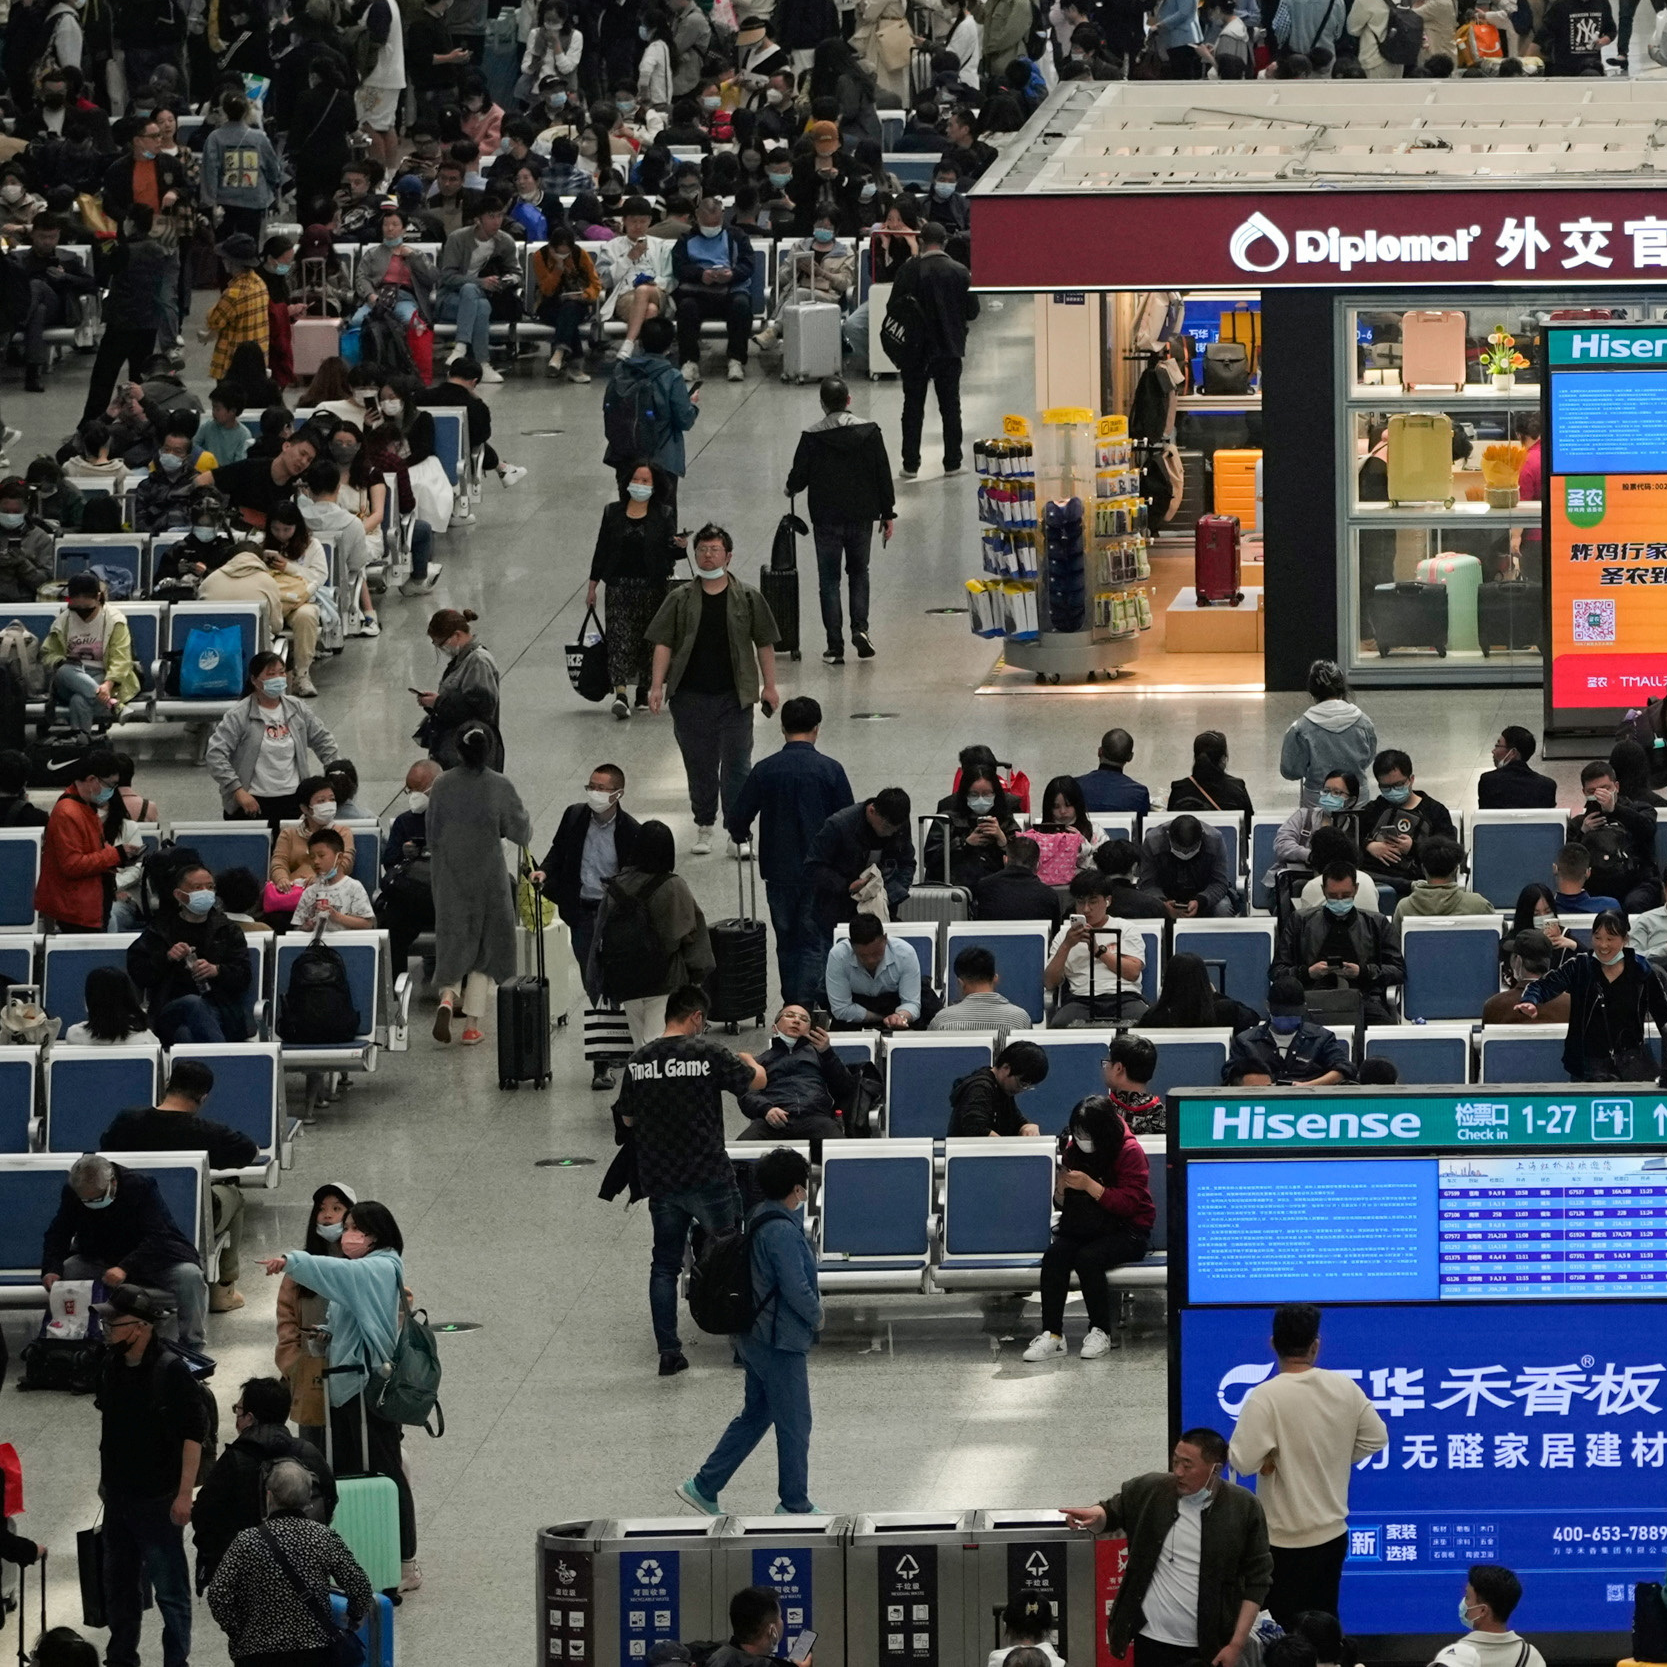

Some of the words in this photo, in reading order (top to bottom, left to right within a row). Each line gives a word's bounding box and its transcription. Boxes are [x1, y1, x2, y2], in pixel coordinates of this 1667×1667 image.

[1296, 223, 1481, 271] Diplomat
[1567, 488, 1604, 507] 圣农
[1587, 676, 1608, 688] 圣农
[664, 1057, 711, 1078] Game
[1211, 1105, 1422, 1141] Hisense
[1455, 1103, 1509, 1126] 检票口
[1520, 1104, 1577, 1134] 1-27
[1456, 1127, 1491, 1141] Check
[1494, 1127, 1509, 1141] in
[1515, 1160, 1613, 1172] 上海虹桥站欢迎您
[1386, 1523, 1417, 1540] 家装
[1479, 1524, 1495, 1533] 木门
[1351, 1531, 1377, 1556] 新
[1480, 1537, 1495, 1547] 五金
[1385, 1545, 1418, 1562] 选择
[1465, 1550, 1495, 1560] 陶瓷卫浴
[895, 1582, 921, 1591] 干垃圾
[1025, 1578, 1050, 1588] 干垃圾
[633, 1587, 667, 1597] 可回收物
